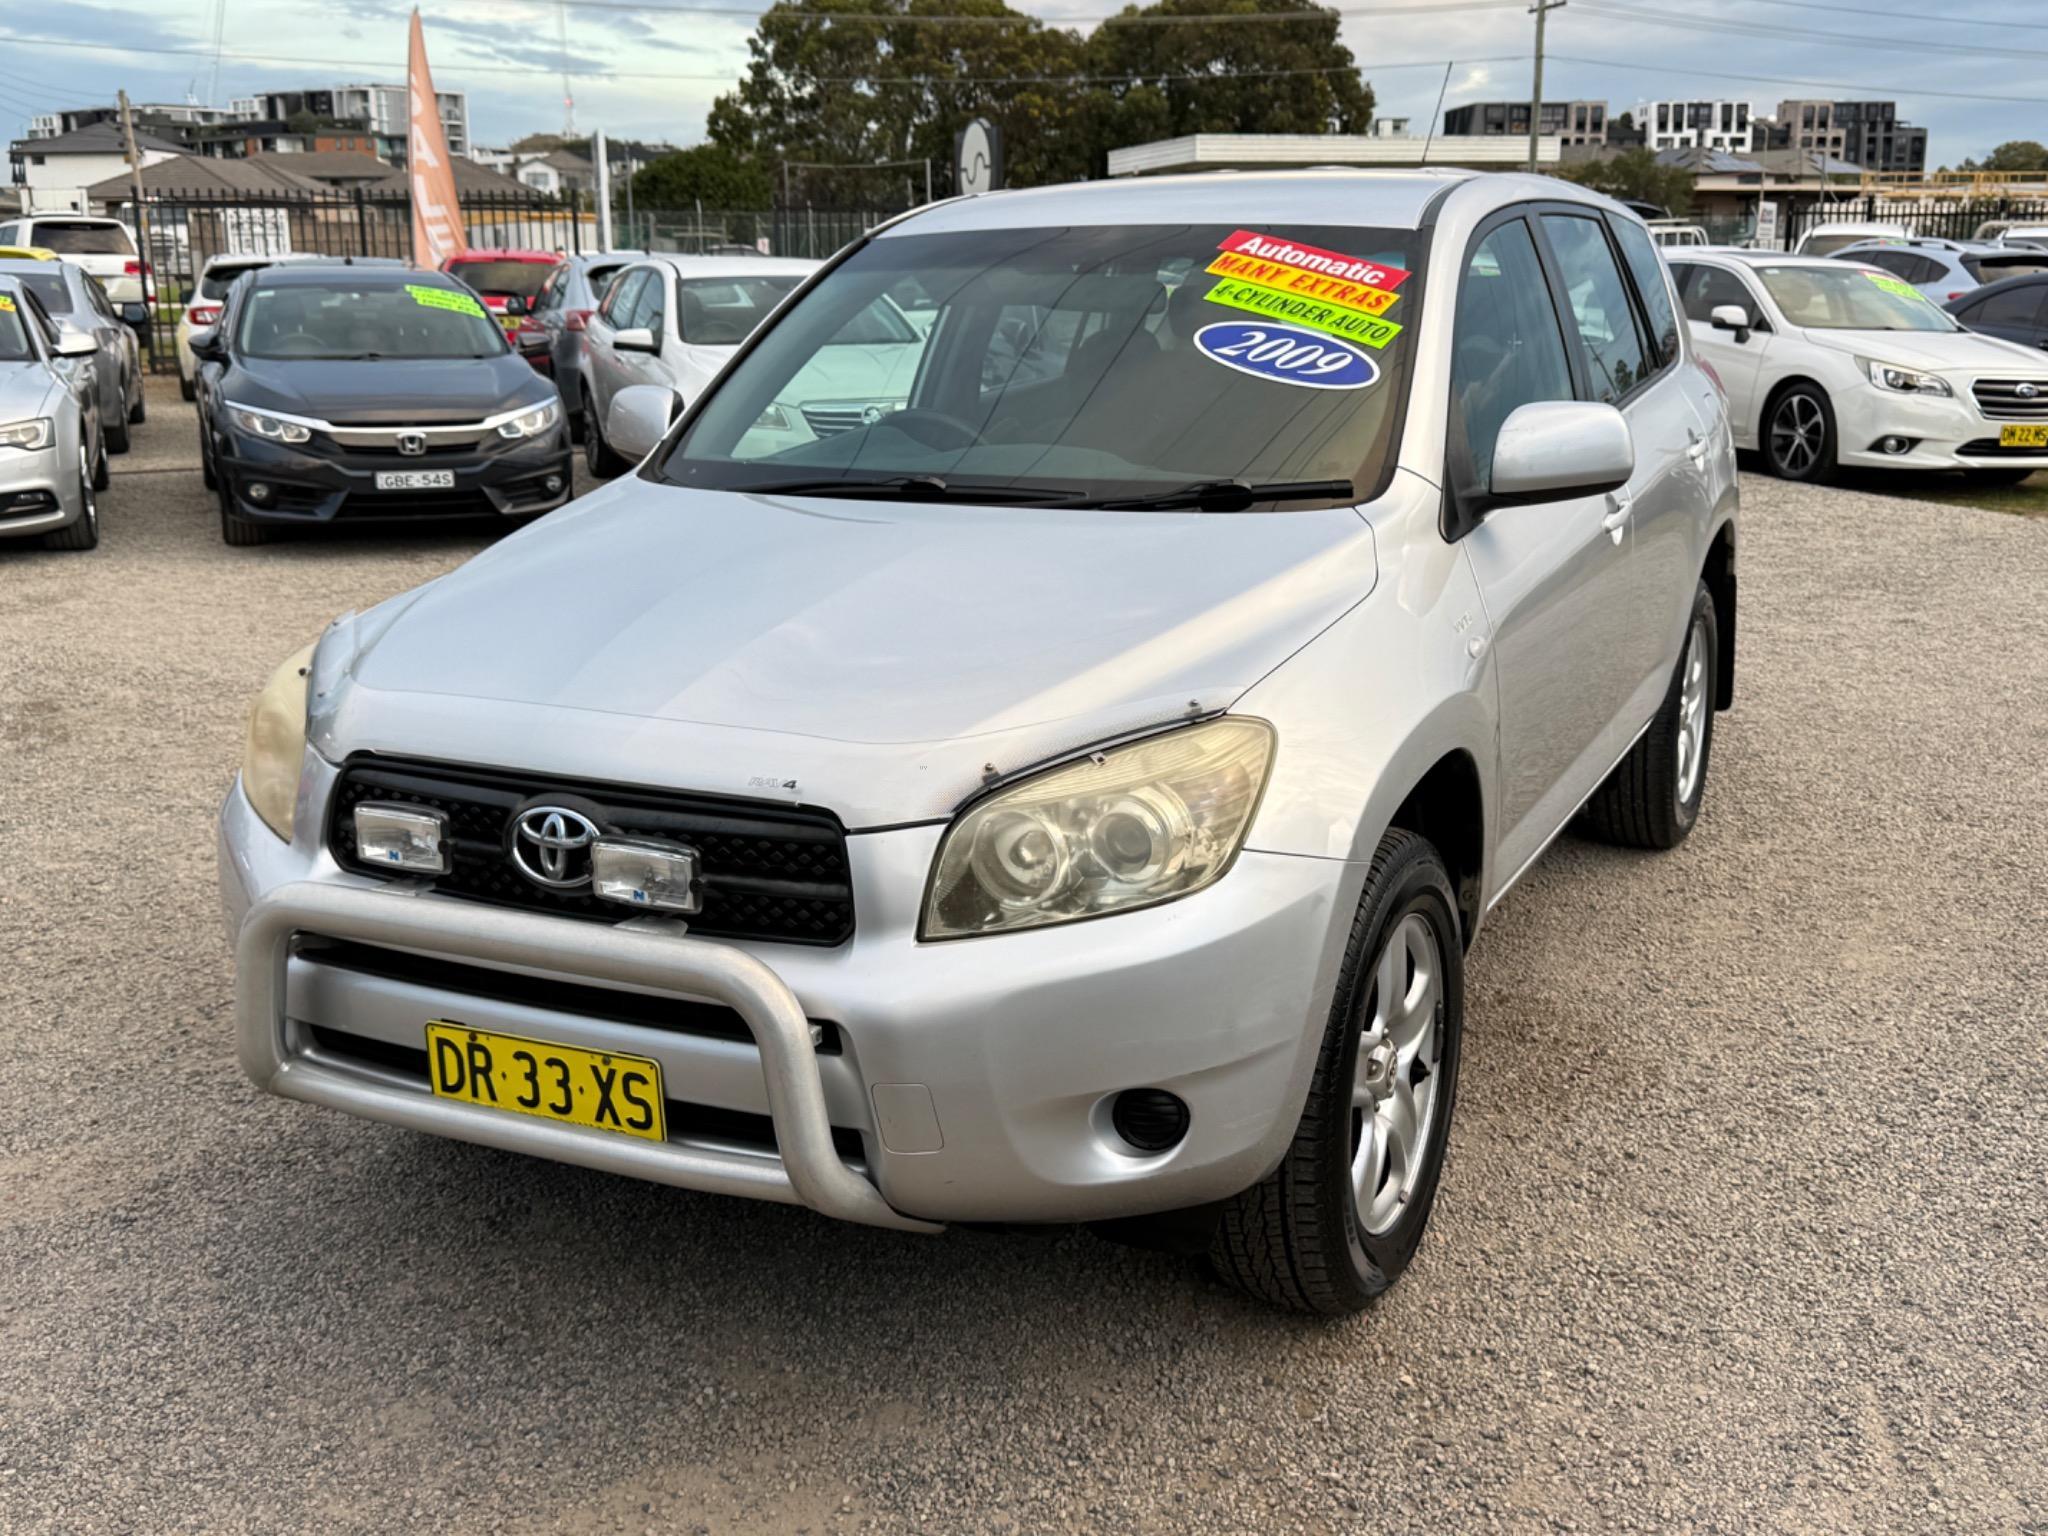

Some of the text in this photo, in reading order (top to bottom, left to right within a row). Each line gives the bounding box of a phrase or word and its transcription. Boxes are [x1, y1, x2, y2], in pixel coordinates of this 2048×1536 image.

[1212, 254, 1390, 309] MANY EXTRAS
[1235, 236, 1386, 285] Automatic
[1215, 283, 1390, 341] 4-CYLINDER AUTO
[1213, 331, 1353, 374] 2009
